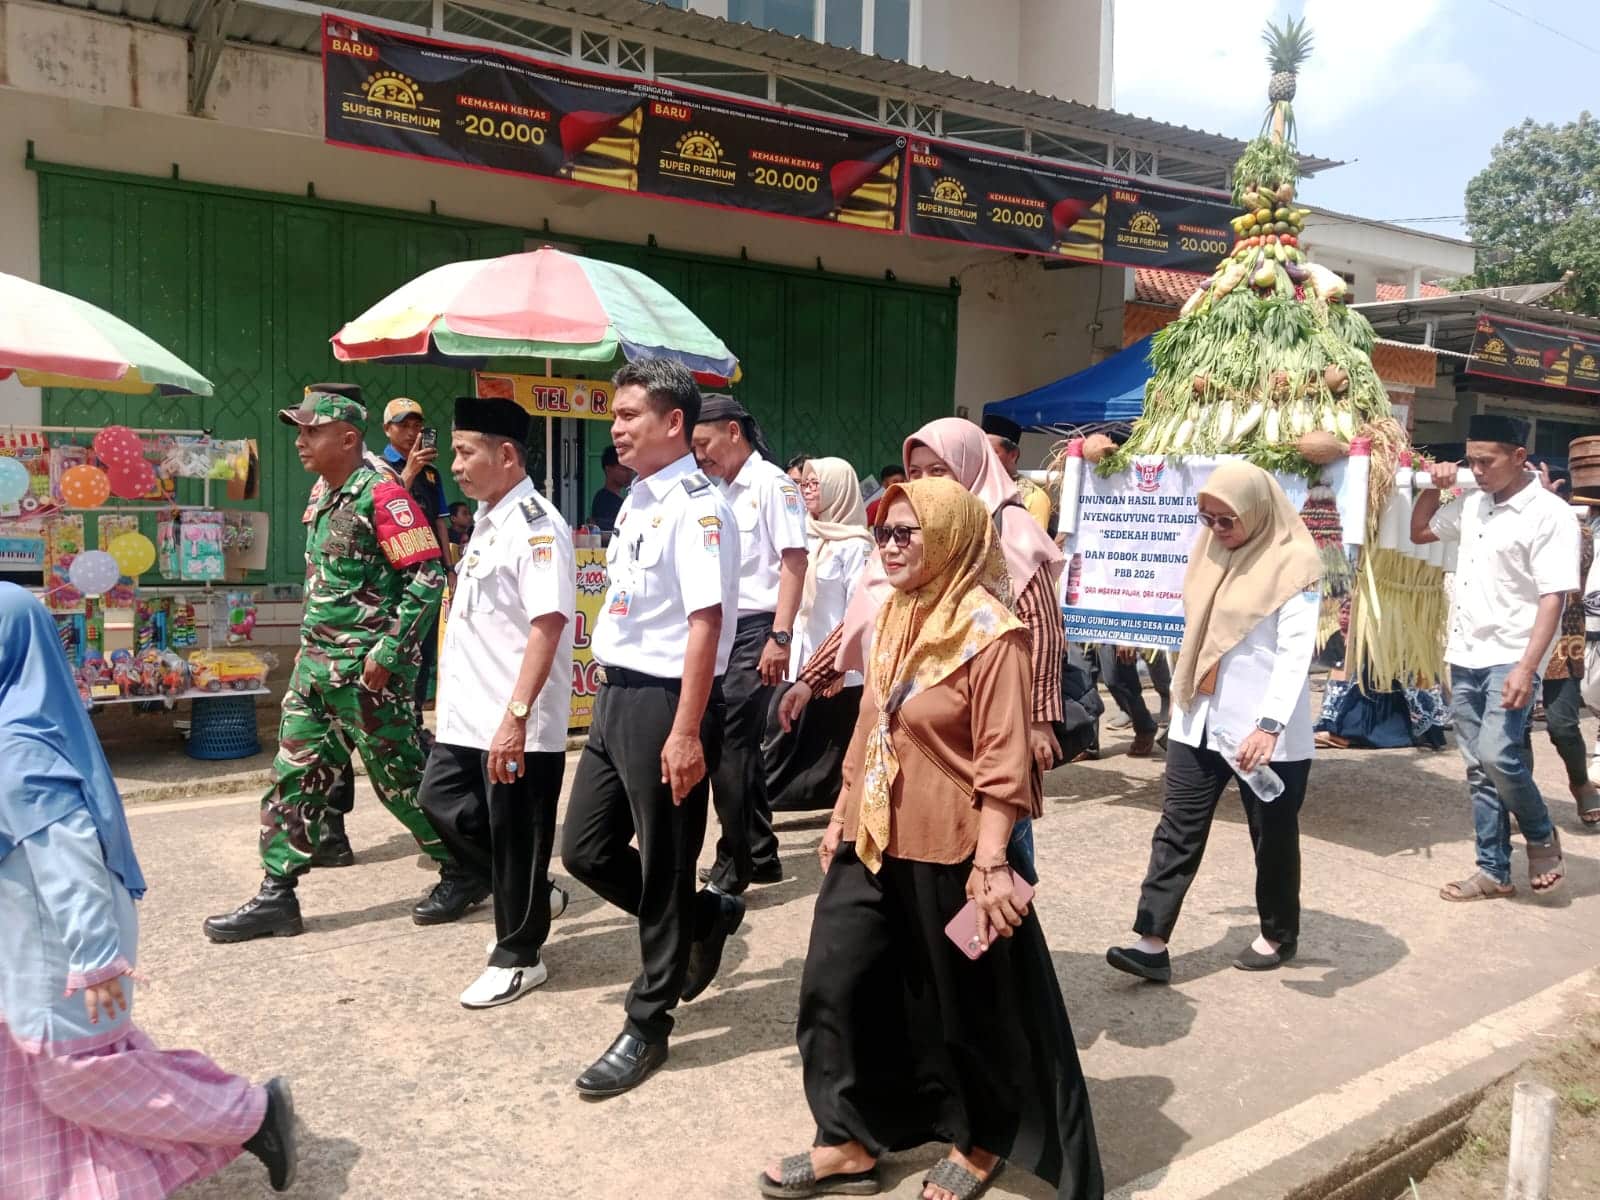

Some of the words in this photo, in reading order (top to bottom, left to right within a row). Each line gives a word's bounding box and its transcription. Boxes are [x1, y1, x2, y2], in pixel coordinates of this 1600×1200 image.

[332, 39, 374, 58] BARU
[373, 85, 410, 104] 234
[342, 101, 382, 118] SUPER
[385, 110, 441, 129] PREMIUM
[460, 96, 508, 113] KEMASAN
[511, 104, 546, 120] KERTAS
[655, 103, 687, 119] BARU
[684, 142, 713, 159] 234
[752, 151, 789, 164] KEMASAN
[791, 158, 820, 170] KERTAS
[913, 154, 938, 167] BARU
[659, 158, 691, 172] SUPER
[693, 164, 736, 181] PREMIUM
[936, 187, 960, 201] 234
[990, 193, 1022, 204] KEMASAN
[1115, 191, 1137, 202] BARU
[917, 202, 943, 213] SUPER
[944, 207, 977, 220] PREMIUM
[992, 207, 1043, 229] 20.000
[1134, 220, 1153, 232] 234
[1117, 234, 1139, 244] SUPER
[1139, 238, 1169, 249] PREMIUM
[1181, 237, 1227, 255] 20.000
[1514, 355, 1540, 368] 20.000
[1079, 495, 1126, 505] UNUNGAN
[1128, 495, 1157, 506] HASIL
[1158, 496, 1185, 506] BUMI
[1083, 512, 1155, 523] NYENGKUYUNG
[1157, 513, 1197, 525] TRADISI
[1085, 550, 1106, 560] DAN
[1107, 551, 1138, 562] BOBOK
[1140, 553, 1188, 564] BUMBUNG
[1114, 568, 1132, 578] PBB
[1134, 569, 1155, 579] 2026
[1088, 616, 1119, 626] GUNUNG
[1121, 618, 1141, 629] WILIS
[1143, 620, 1163, 630] DESA
[1164, 622, 1184, 632] KARA
[1065, 626, 1108, 638] KECAMATAN
[1108, 631, 1132, 640] CIPARI
[1133, 633, 1176, 644] KABUPATEN
